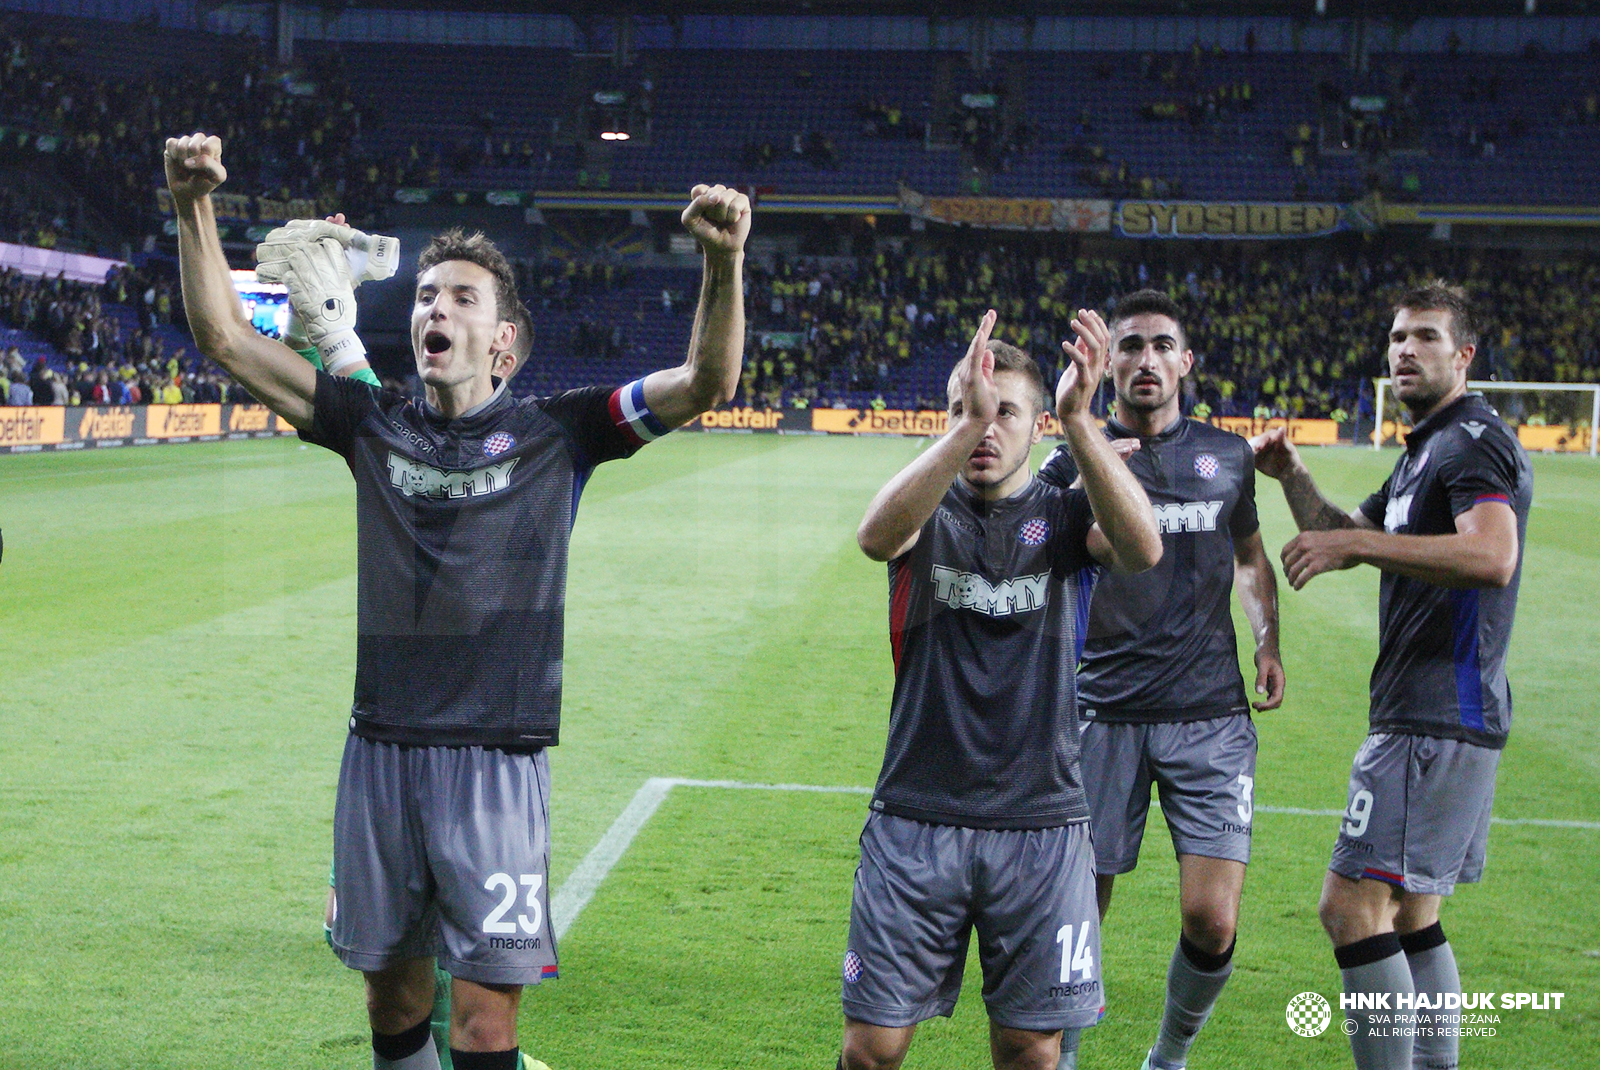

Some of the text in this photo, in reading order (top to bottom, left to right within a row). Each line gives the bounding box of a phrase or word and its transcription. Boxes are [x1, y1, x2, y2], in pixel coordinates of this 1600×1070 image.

[376, 236, 389, 258] DANT
[390, 420, 437, 457] macron
[387, 450, 521, 499] TOMMY
[930, 564, 1052, 617] TOMMY
[1237, 773, 1254, 823] 3
[1345, 789, 1374, 838] 9
[1222, 822, 1253, 837] macr
[482, 872, 543, 935] 23
[489, 936, 541, 950] macron
[1056, 920, 1094, 983] 14
[1049, 980, 1100, 998] macron
